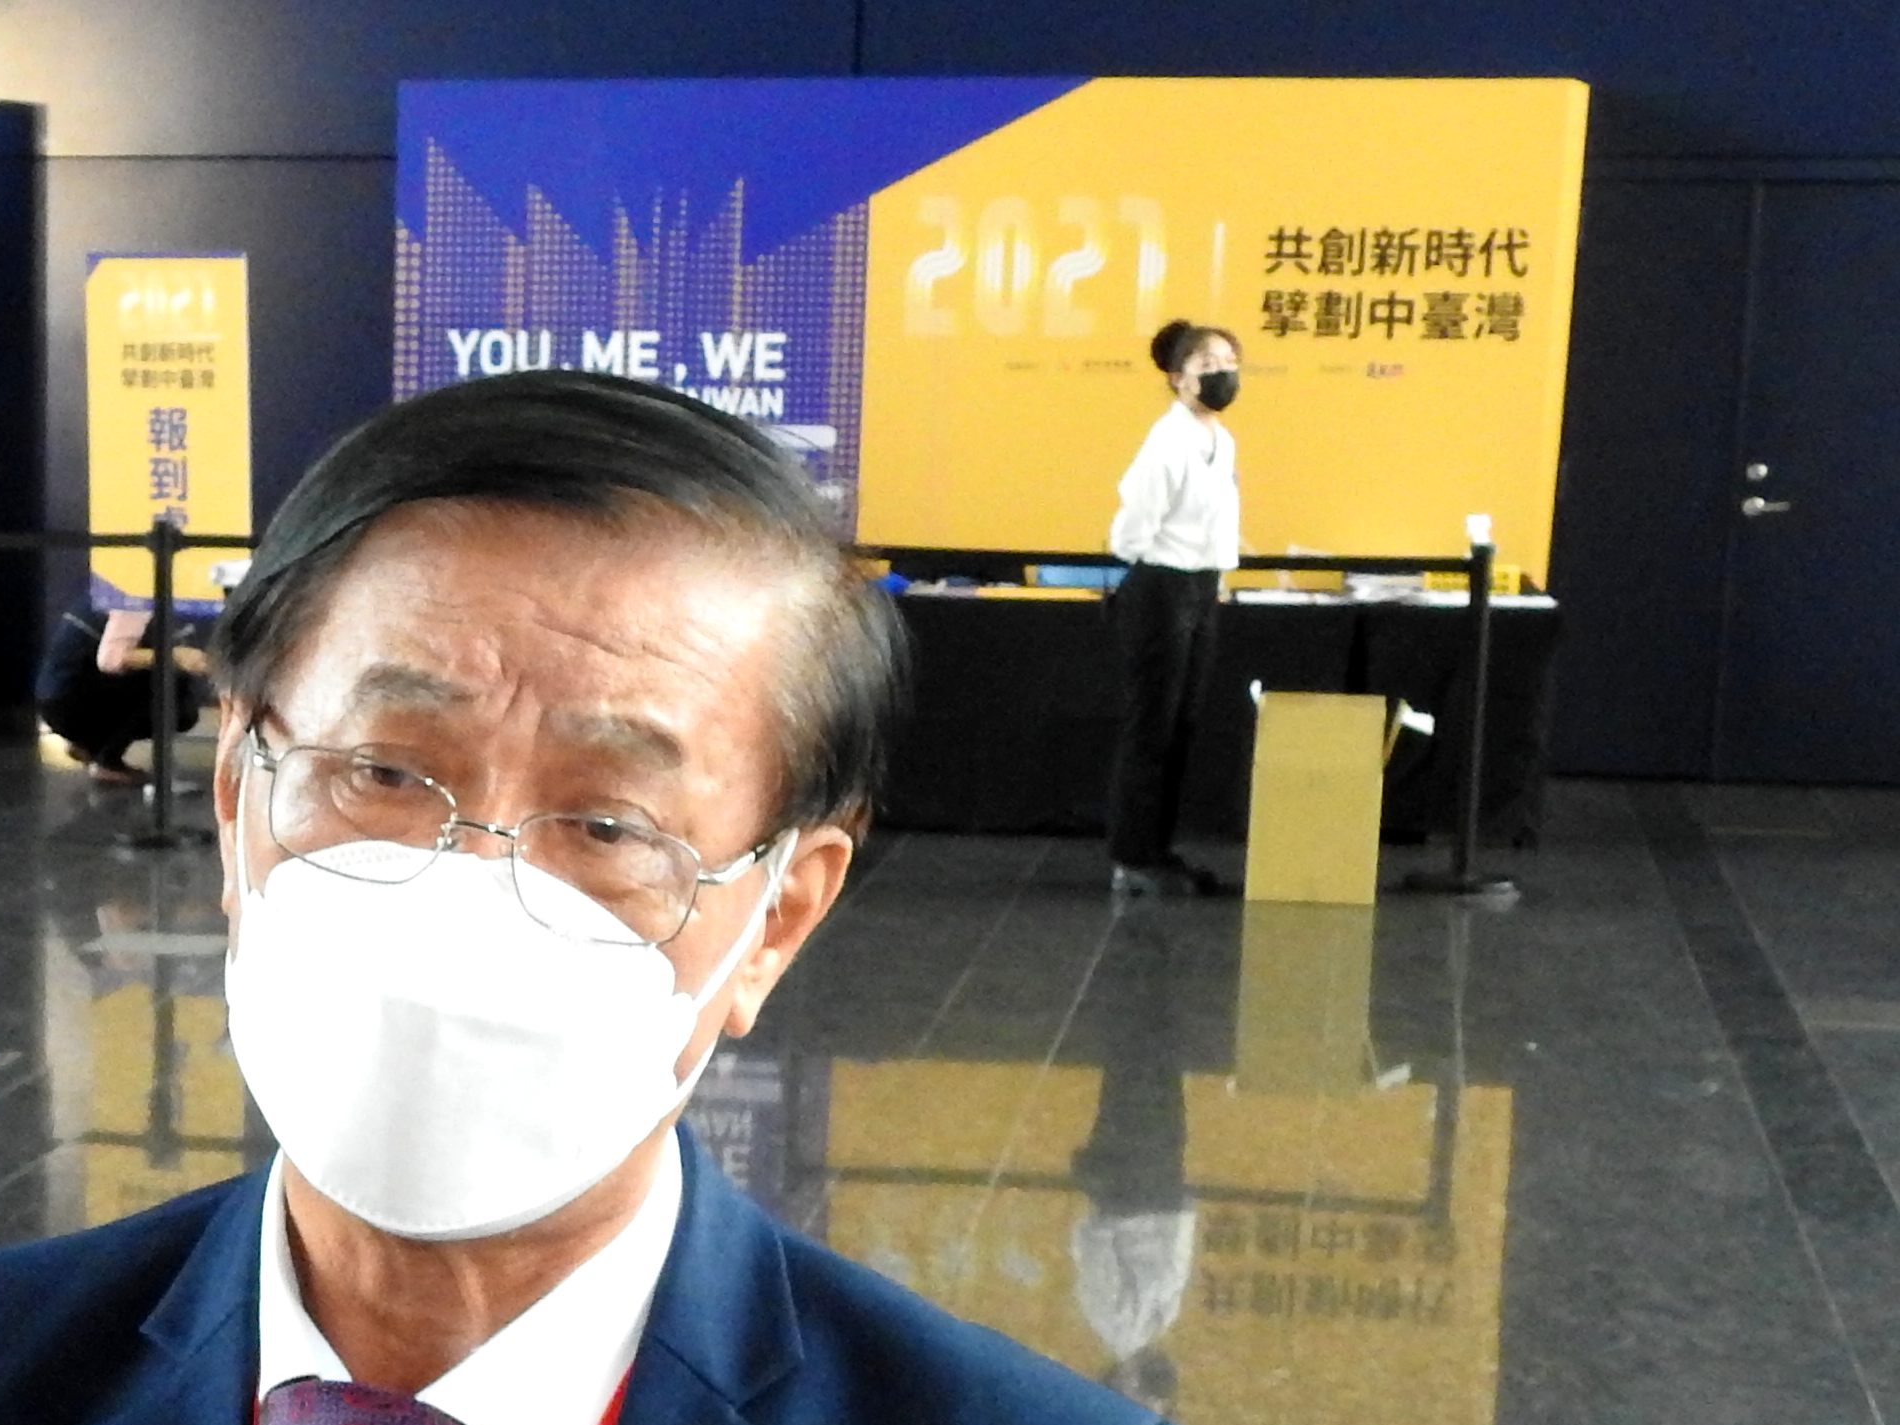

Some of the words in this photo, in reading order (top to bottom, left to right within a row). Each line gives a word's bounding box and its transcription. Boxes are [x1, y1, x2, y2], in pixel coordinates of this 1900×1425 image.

[1264, 225, 1531, 277] 共創新時代
[1260, 290, 1525, 341] 擘劃中臺灣
[701, 332, 788, 382] WE
